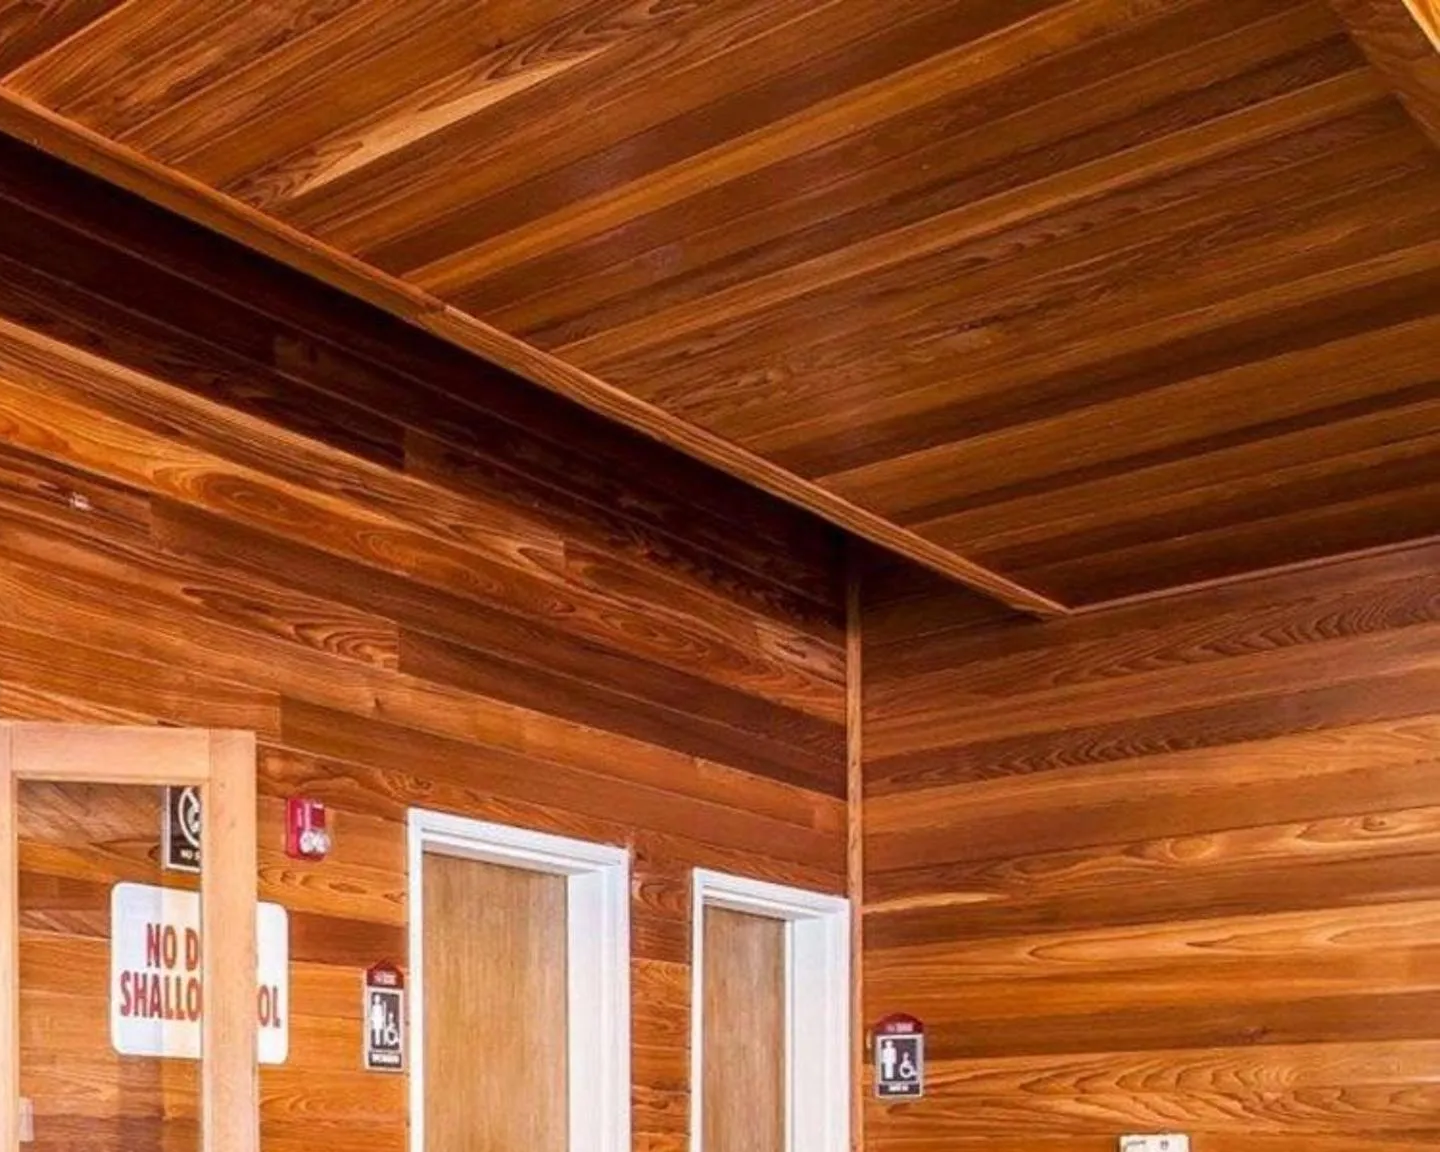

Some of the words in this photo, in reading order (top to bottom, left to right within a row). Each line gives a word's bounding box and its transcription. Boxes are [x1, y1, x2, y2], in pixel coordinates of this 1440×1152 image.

[146, 923, 177, 969] NO
[120, 970, 202, 1023] SHALLO
[257, 985, 281, 1029] OL
